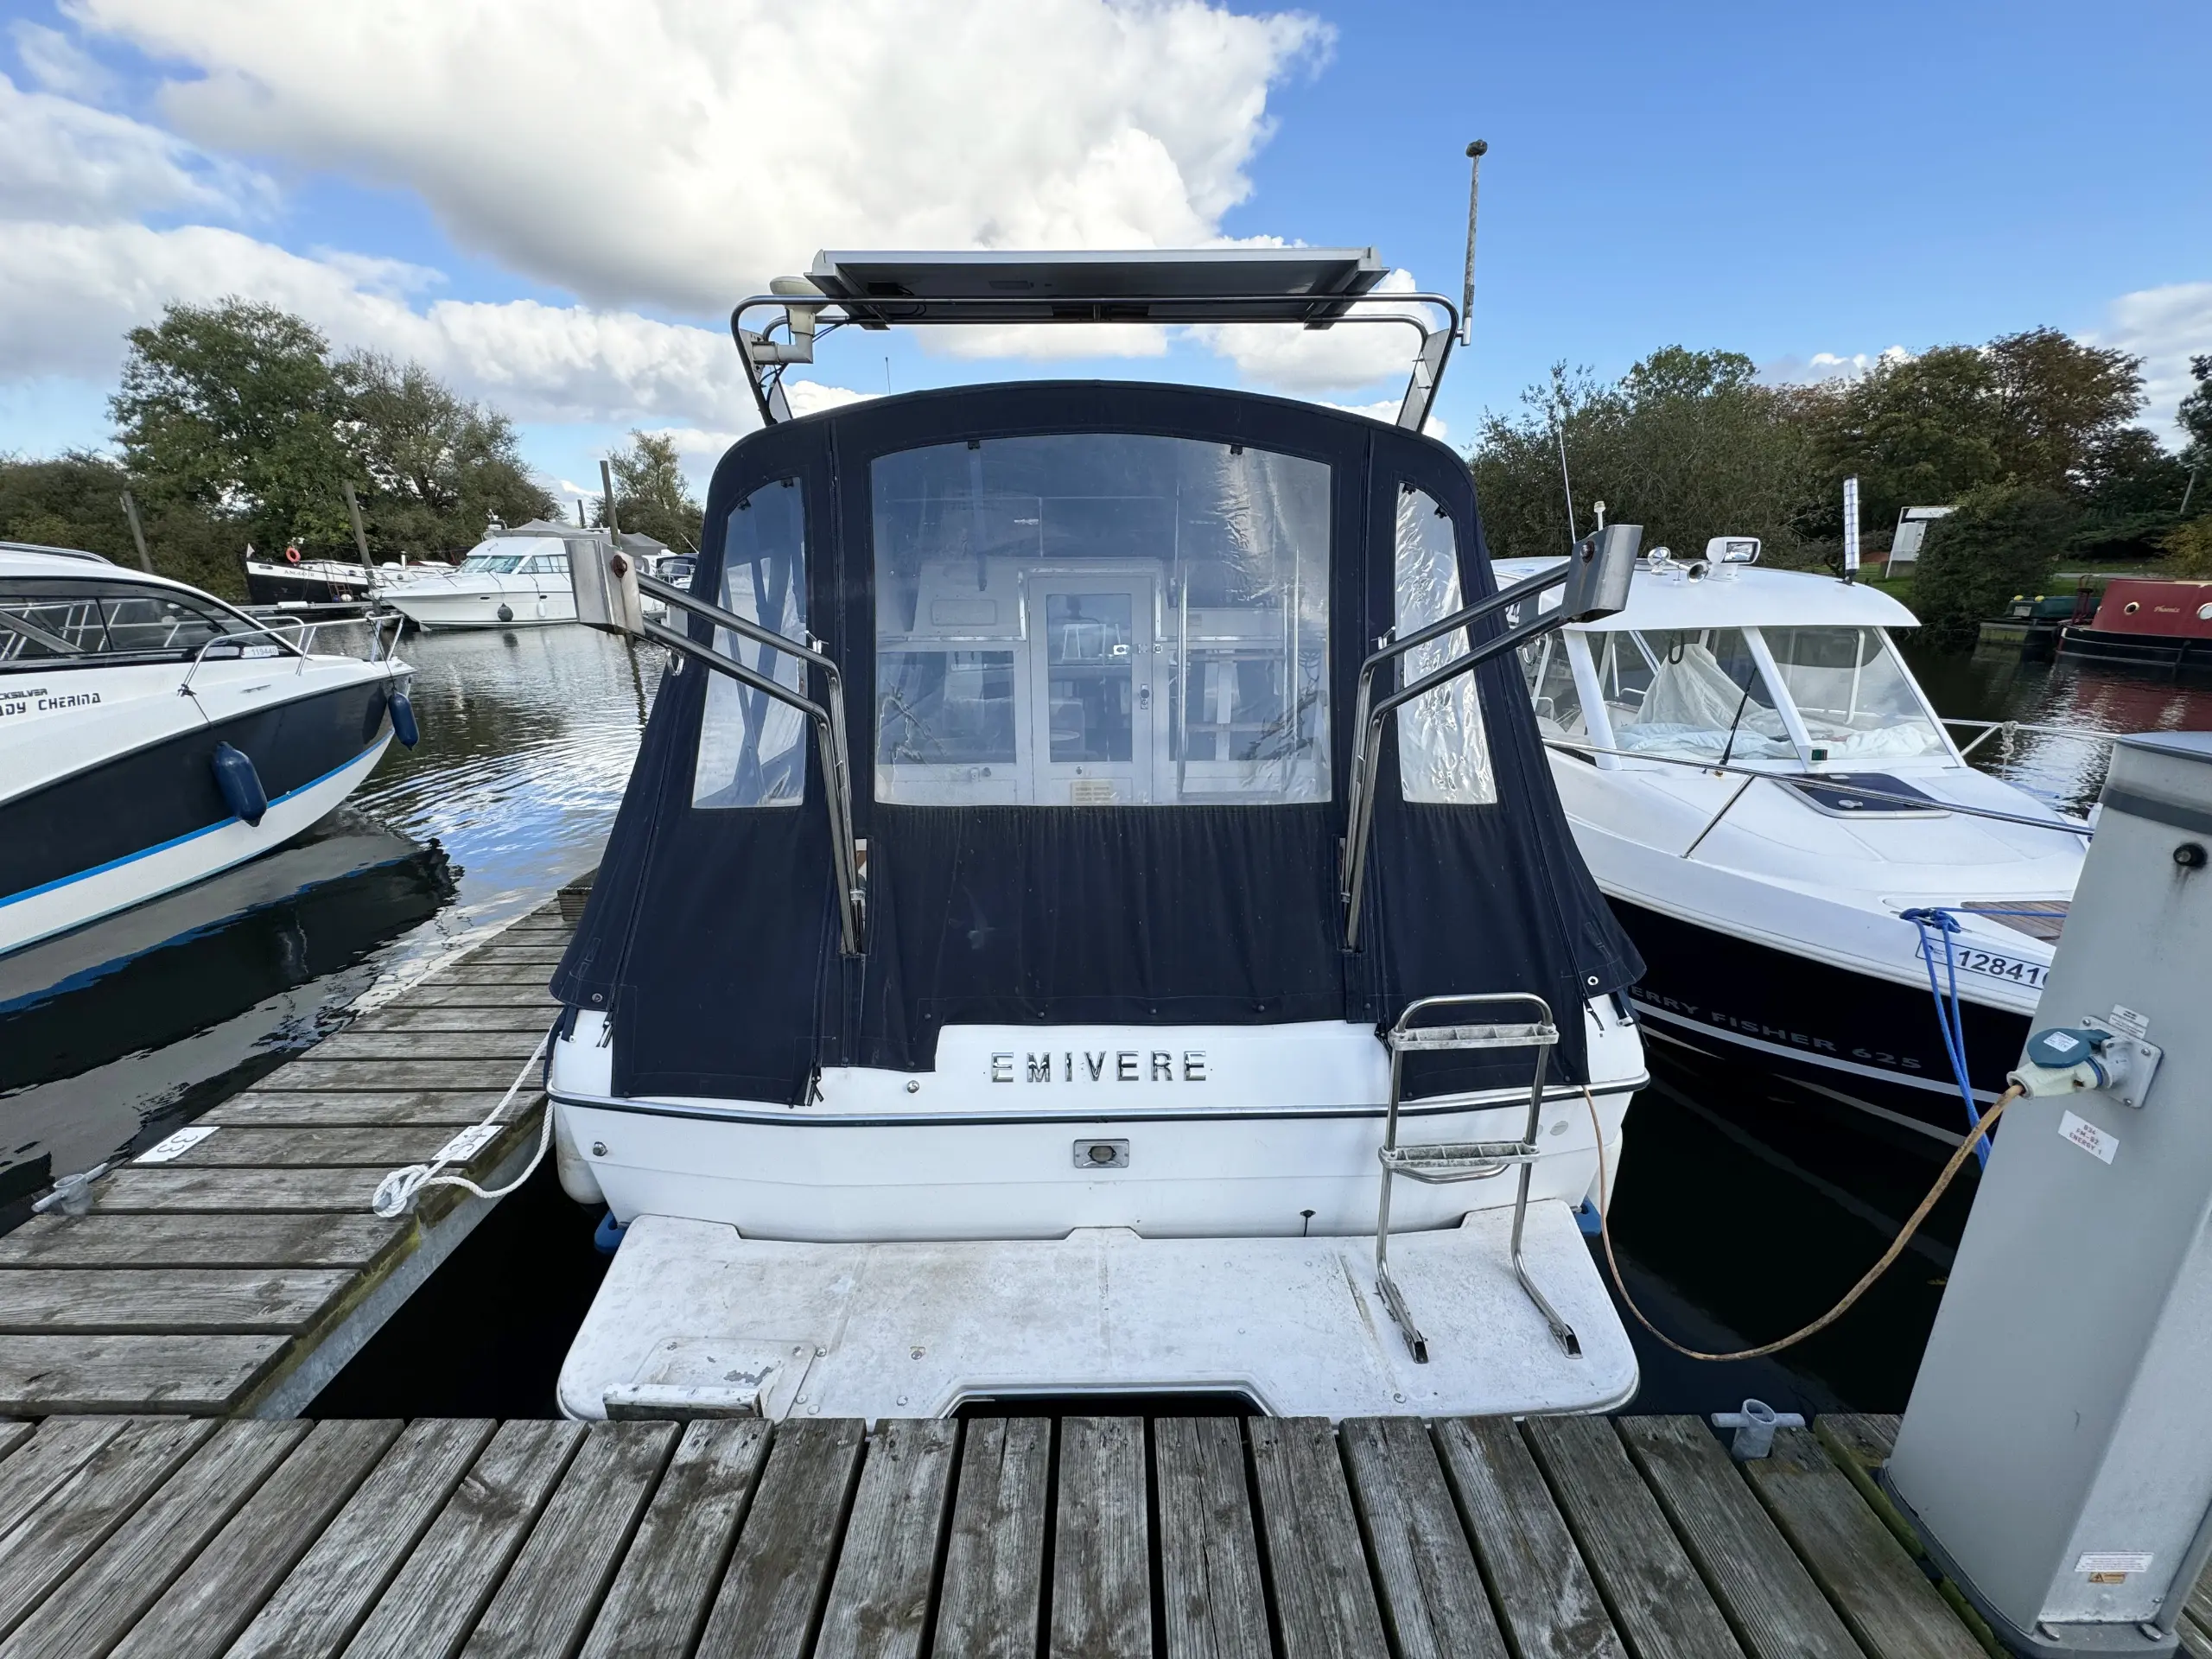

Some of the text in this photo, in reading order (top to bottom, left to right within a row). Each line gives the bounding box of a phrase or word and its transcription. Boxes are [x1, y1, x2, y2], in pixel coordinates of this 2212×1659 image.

[38, 692, 102, 711] CHERINA
[1958, 950, 2049, 986] 12841
[1711, 1010, 1838, 1052] FISHER
[1852, 1047, 1923, 1070] 625
[991, 1050, 1207, 1084] EMIVERE
[156, 1135, 199, 1154] 33
[2069, 1132, 2096, 1151] ENERGY
